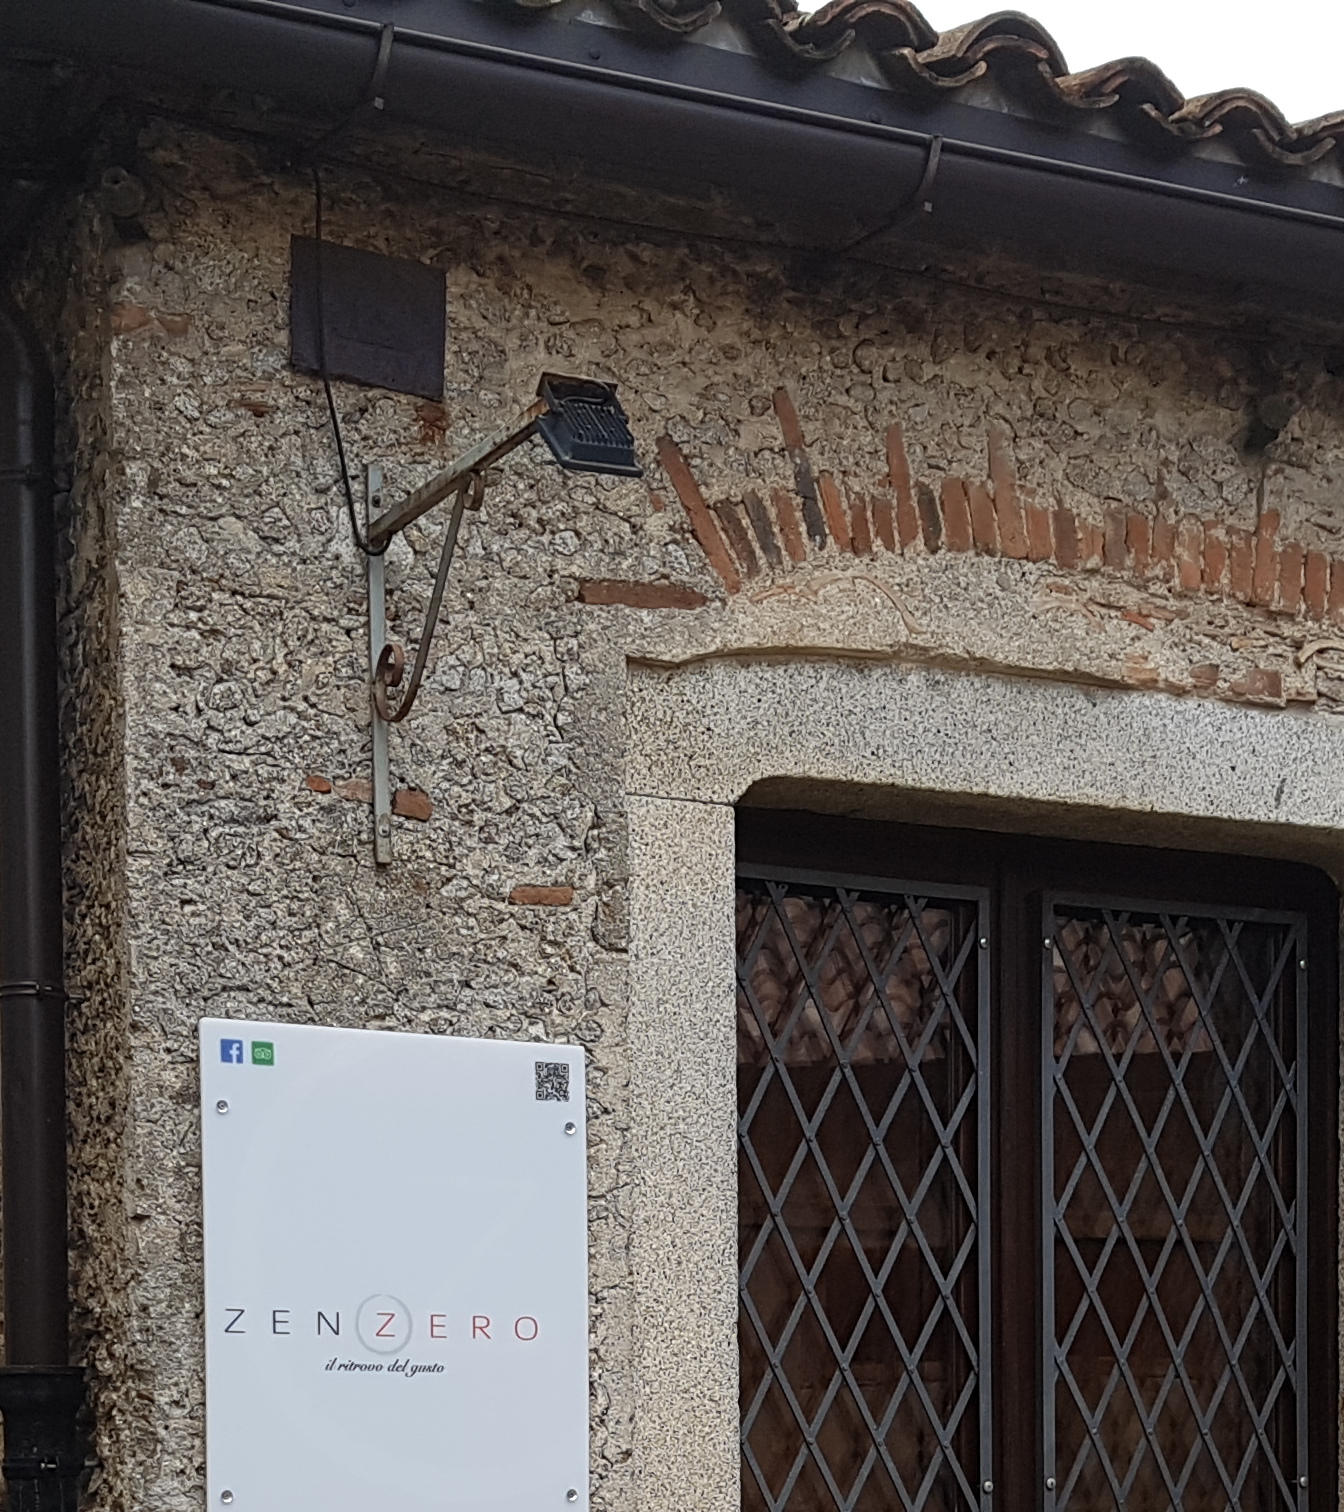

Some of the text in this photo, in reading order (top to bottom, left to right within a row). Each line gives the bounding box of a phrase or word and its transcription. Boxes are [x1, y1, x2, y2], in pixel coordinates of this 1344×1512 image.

[223, 1307, 539, 1342] ZENZERO
[324, 1357, 445, 1378] il ritrovo del gusto
